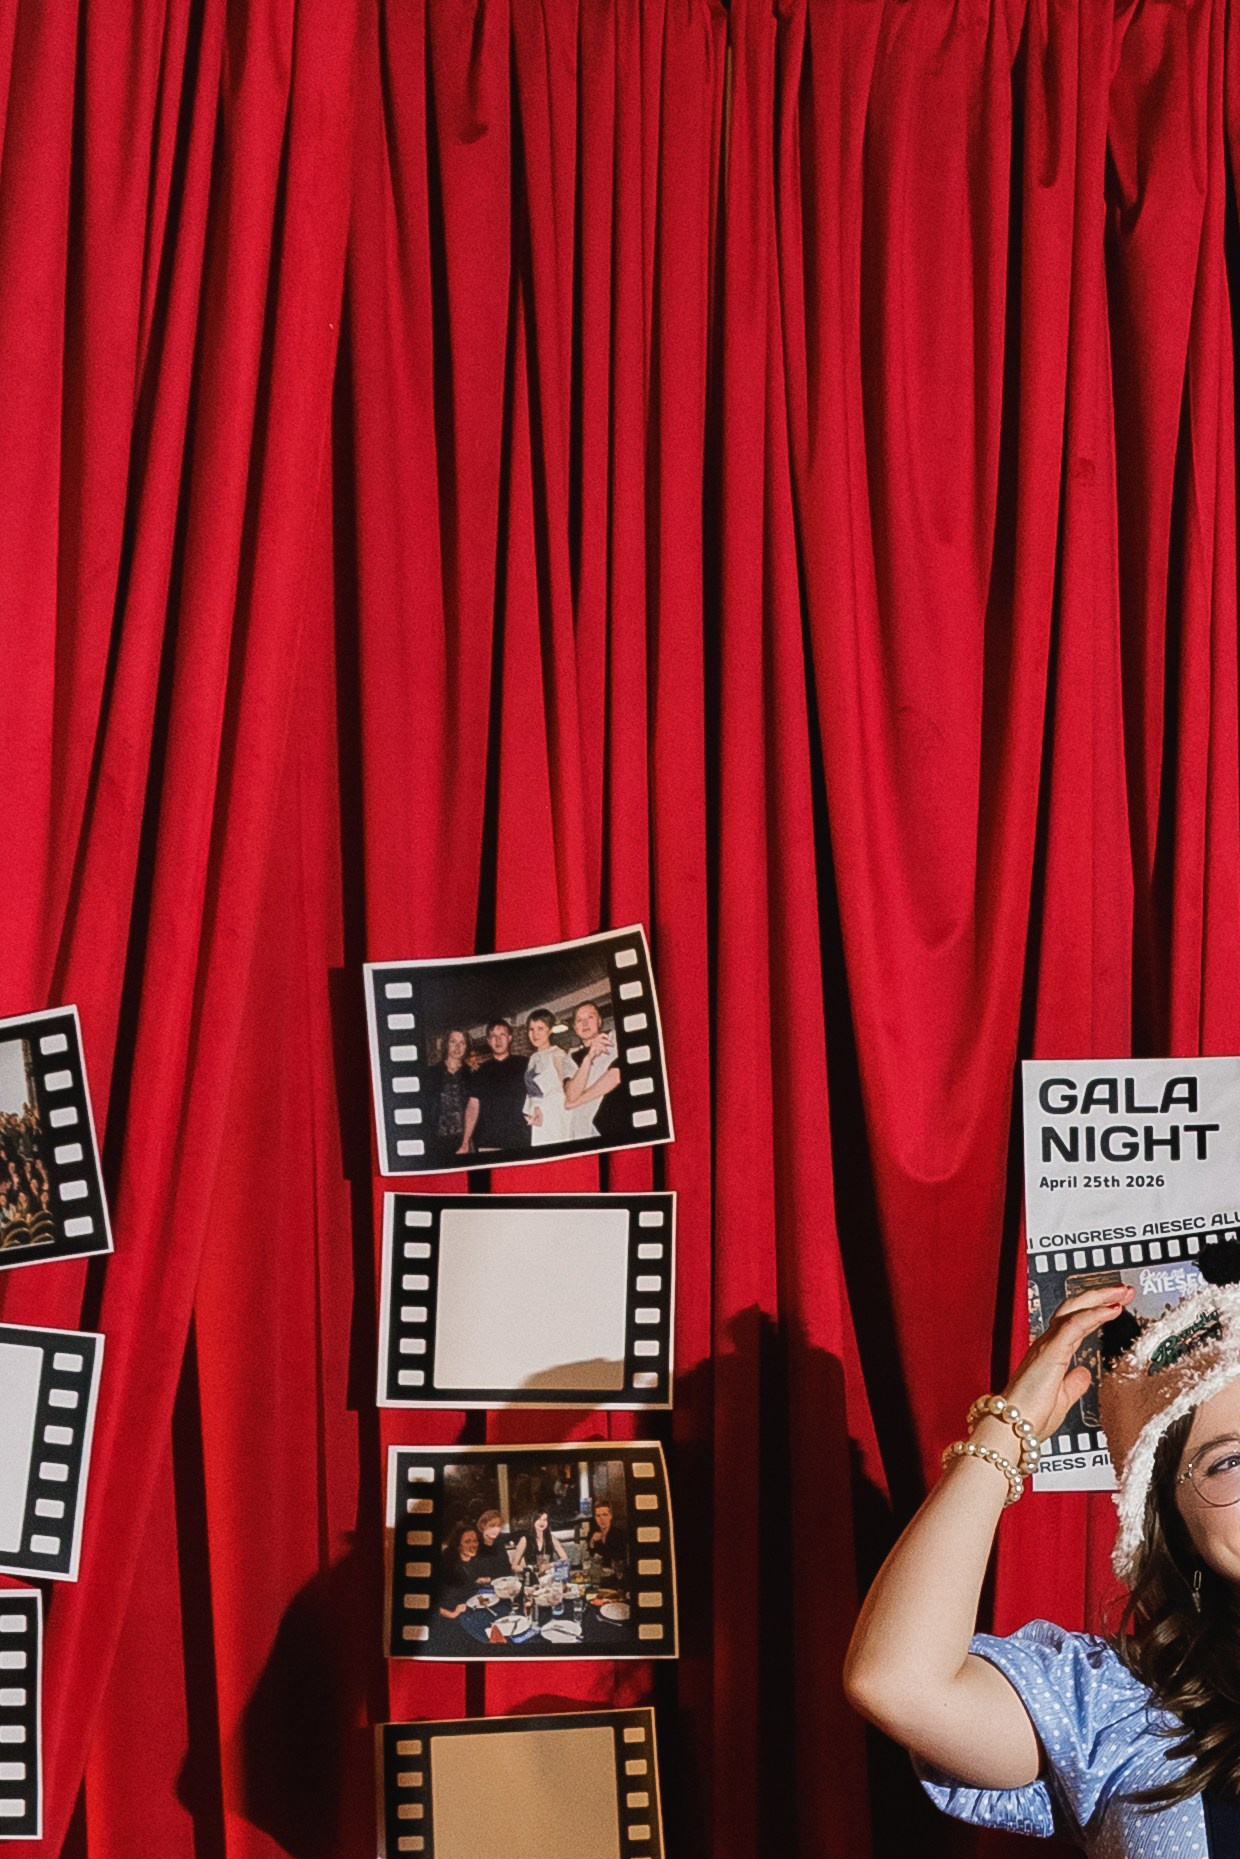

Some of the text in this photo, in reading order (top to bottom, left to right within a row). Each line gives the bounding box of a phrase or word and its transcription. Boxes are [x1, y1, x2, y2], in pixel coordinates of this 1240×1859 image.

[1038, 1076, 1198, 1115] GALA
[1041, 1123, 1220, 1163] NIGHT
[1039, 1174, 1165, 1191] April 25th 2026
[1039, 1226, 1137, 1248] CONGRESS
[1142, 1216, 1206, 1236] AIESEC
[1036, 1456, 1086, 1473] RESS
